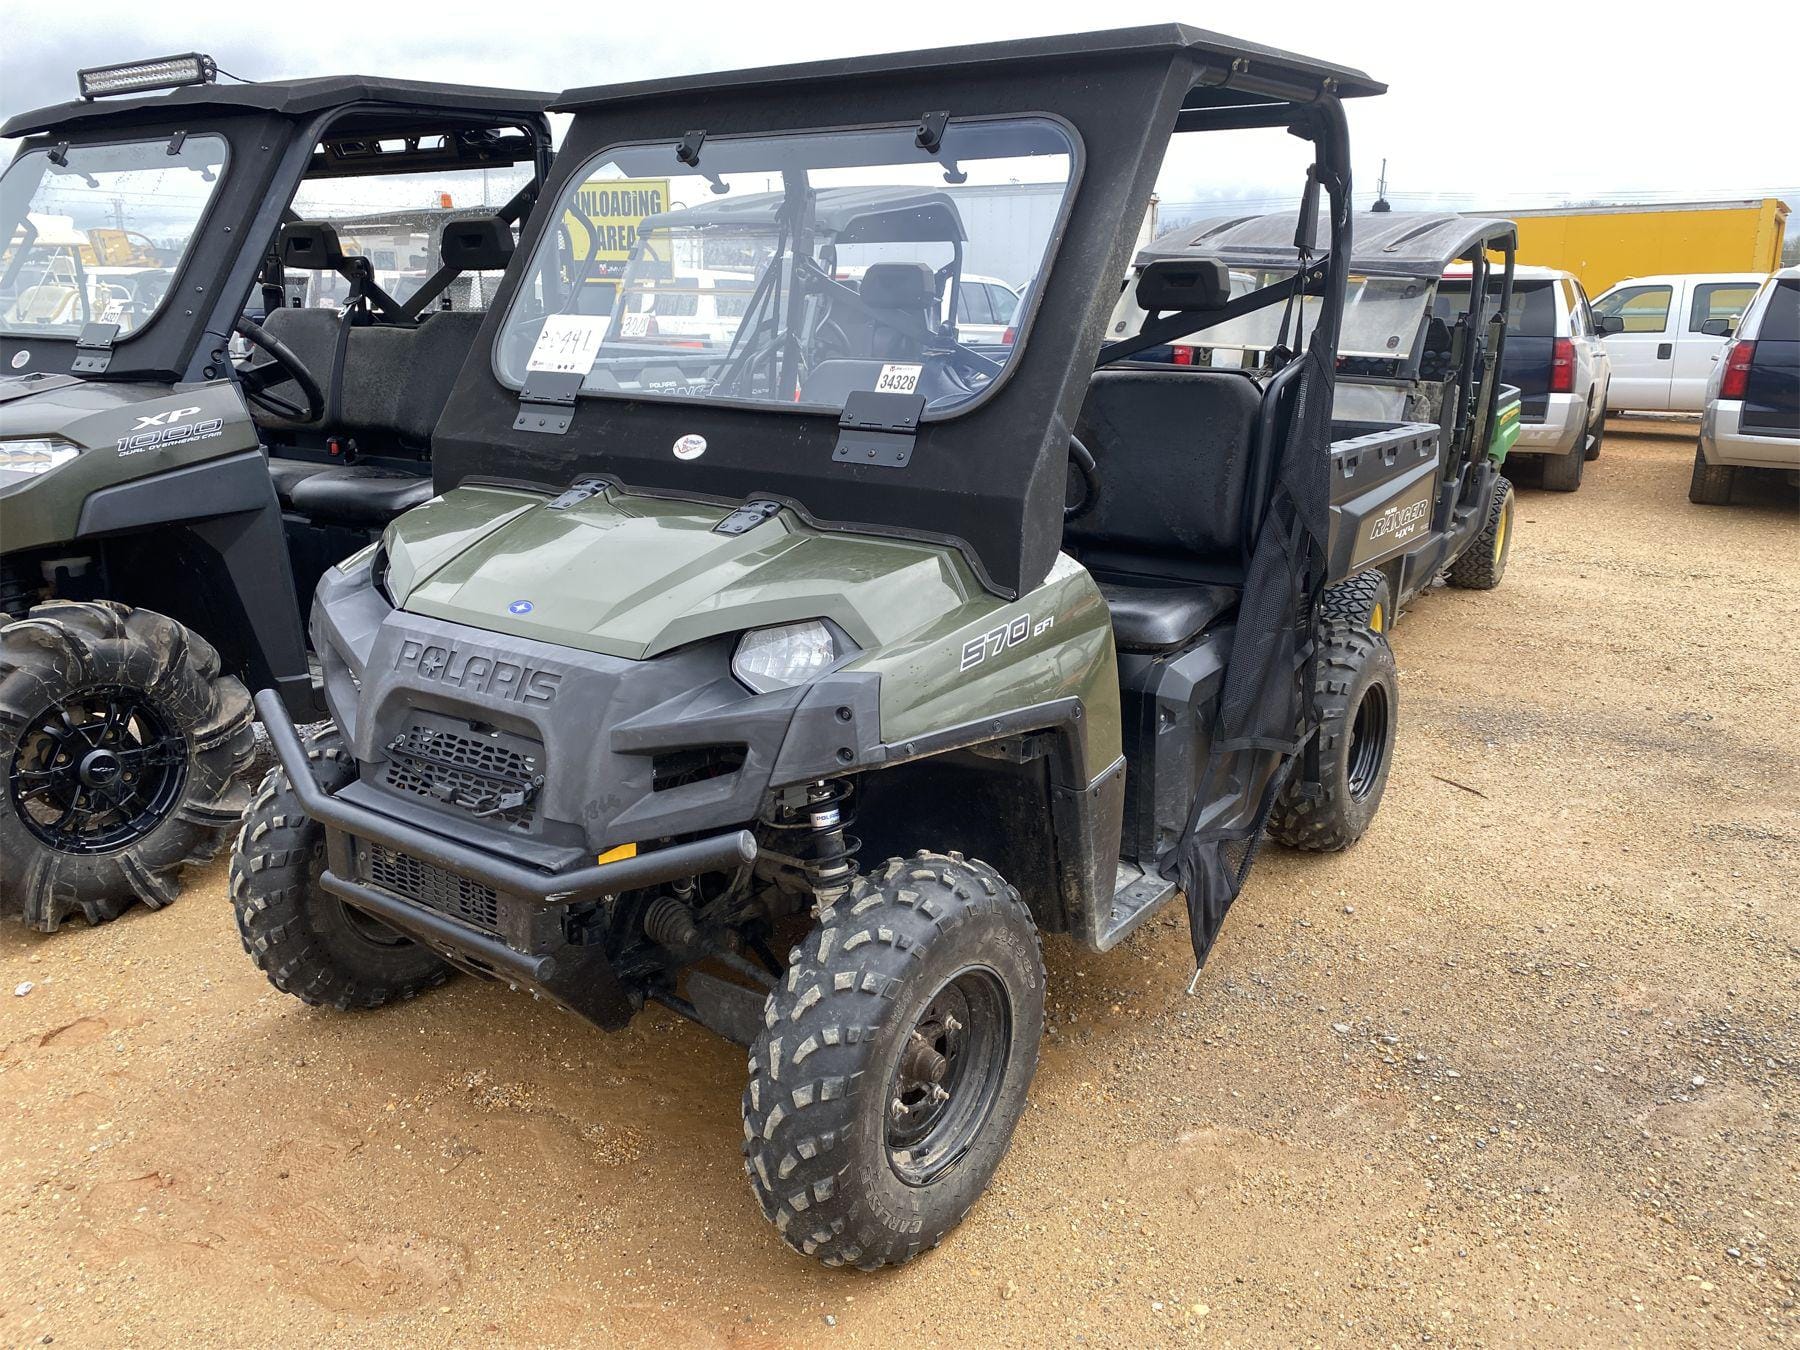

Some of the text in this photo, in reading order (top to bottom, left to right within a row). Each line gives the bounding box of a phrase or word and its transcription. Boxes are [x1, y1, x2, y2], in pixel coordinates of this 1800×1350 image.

[596, 225, 637, 251] AREA
[880, 374, 916, 390] 34328
[130, 406, 201, 431] XP
[117, 417, 224, 452] 1000
[118, 447, 146, 457] DUAL
[201, 431, 223, 440] CAM
[1369, 499, 1429, 541] RANGER
[959, 612, 1055, 672] 570 EFI
[394, 639, 563, 711] POLARIS
